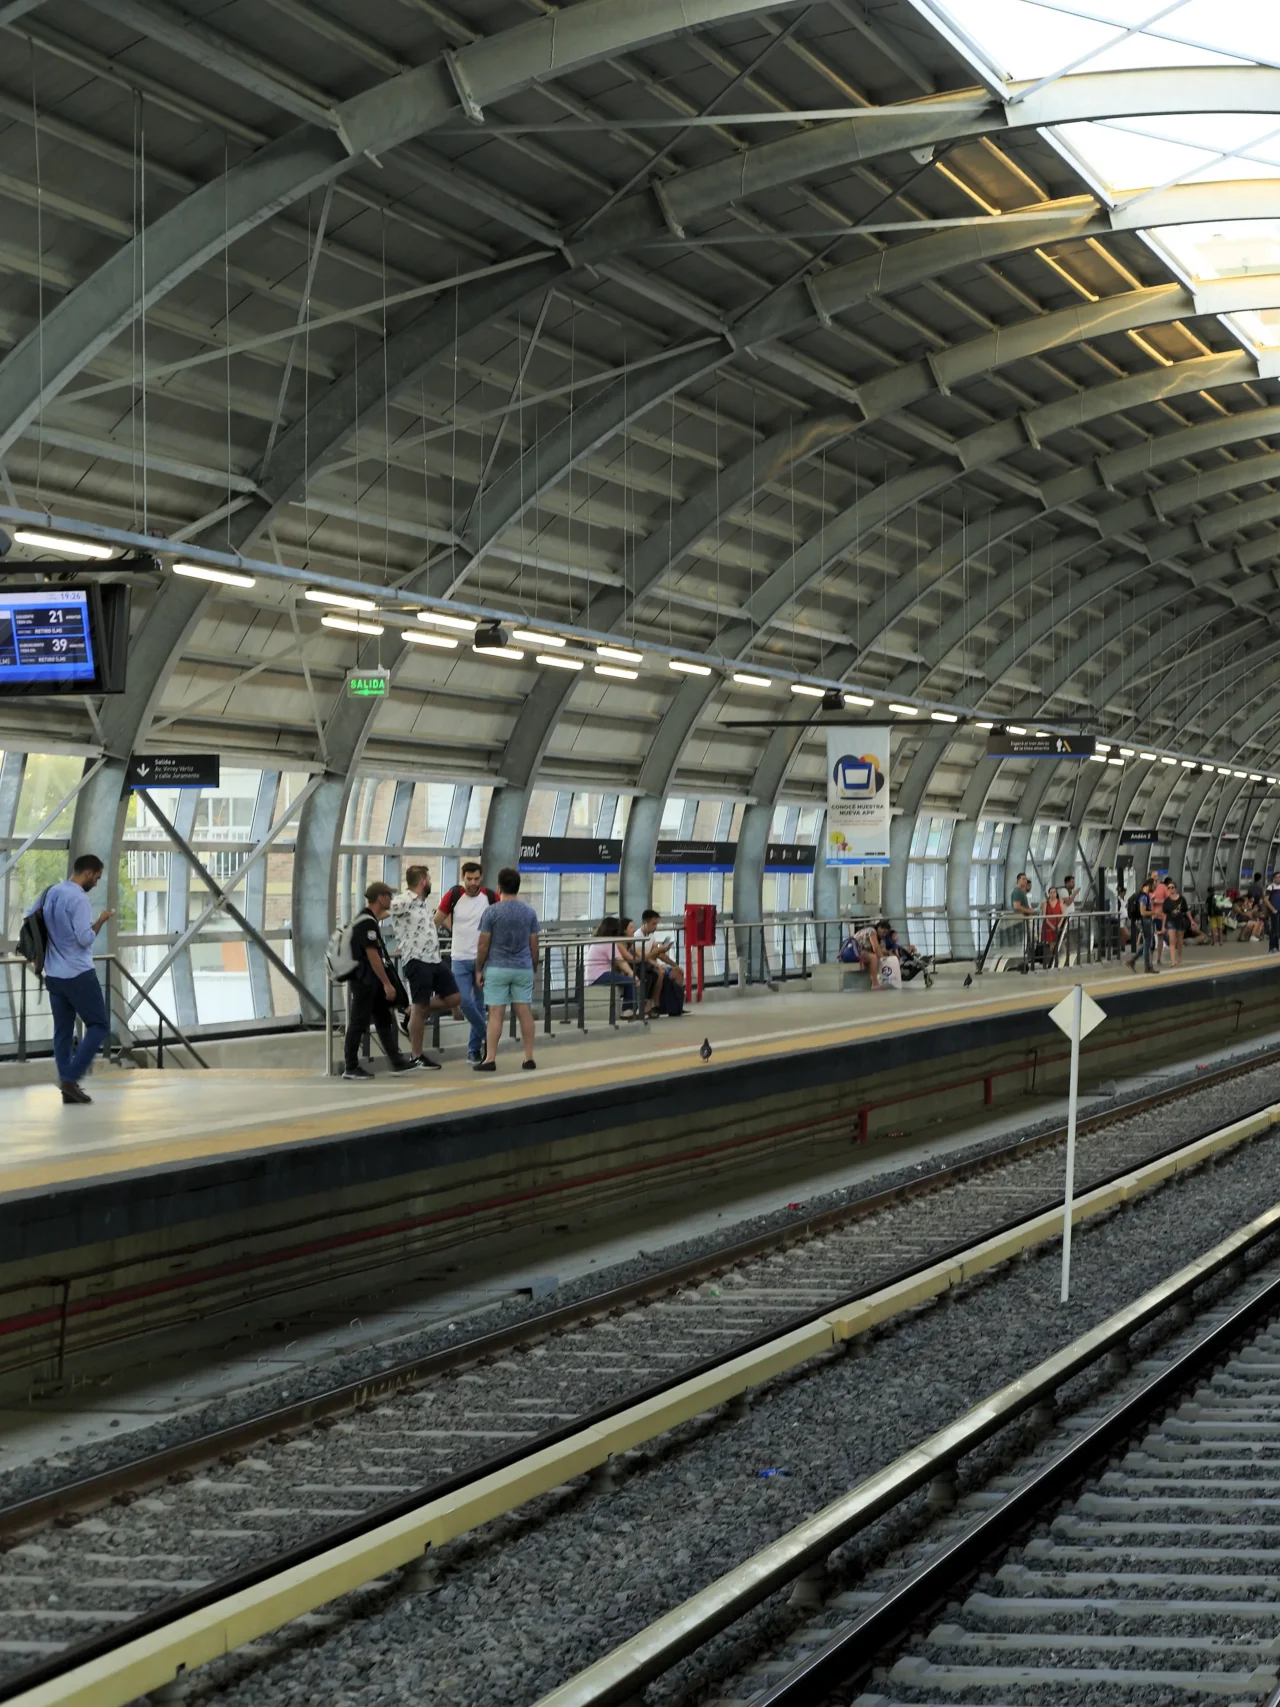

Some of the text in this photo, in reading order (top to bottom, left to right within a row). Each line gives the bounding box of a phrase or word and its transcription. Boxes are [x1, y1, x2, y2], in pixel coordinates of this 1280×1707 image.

[60, 592, 81, 600] 19:26
[48, 609, 63, 623] 21
[52, 638, 67, 652] 39
[351, 679, 385, 689] SALIDA
[535, 843, 540, 857] C
